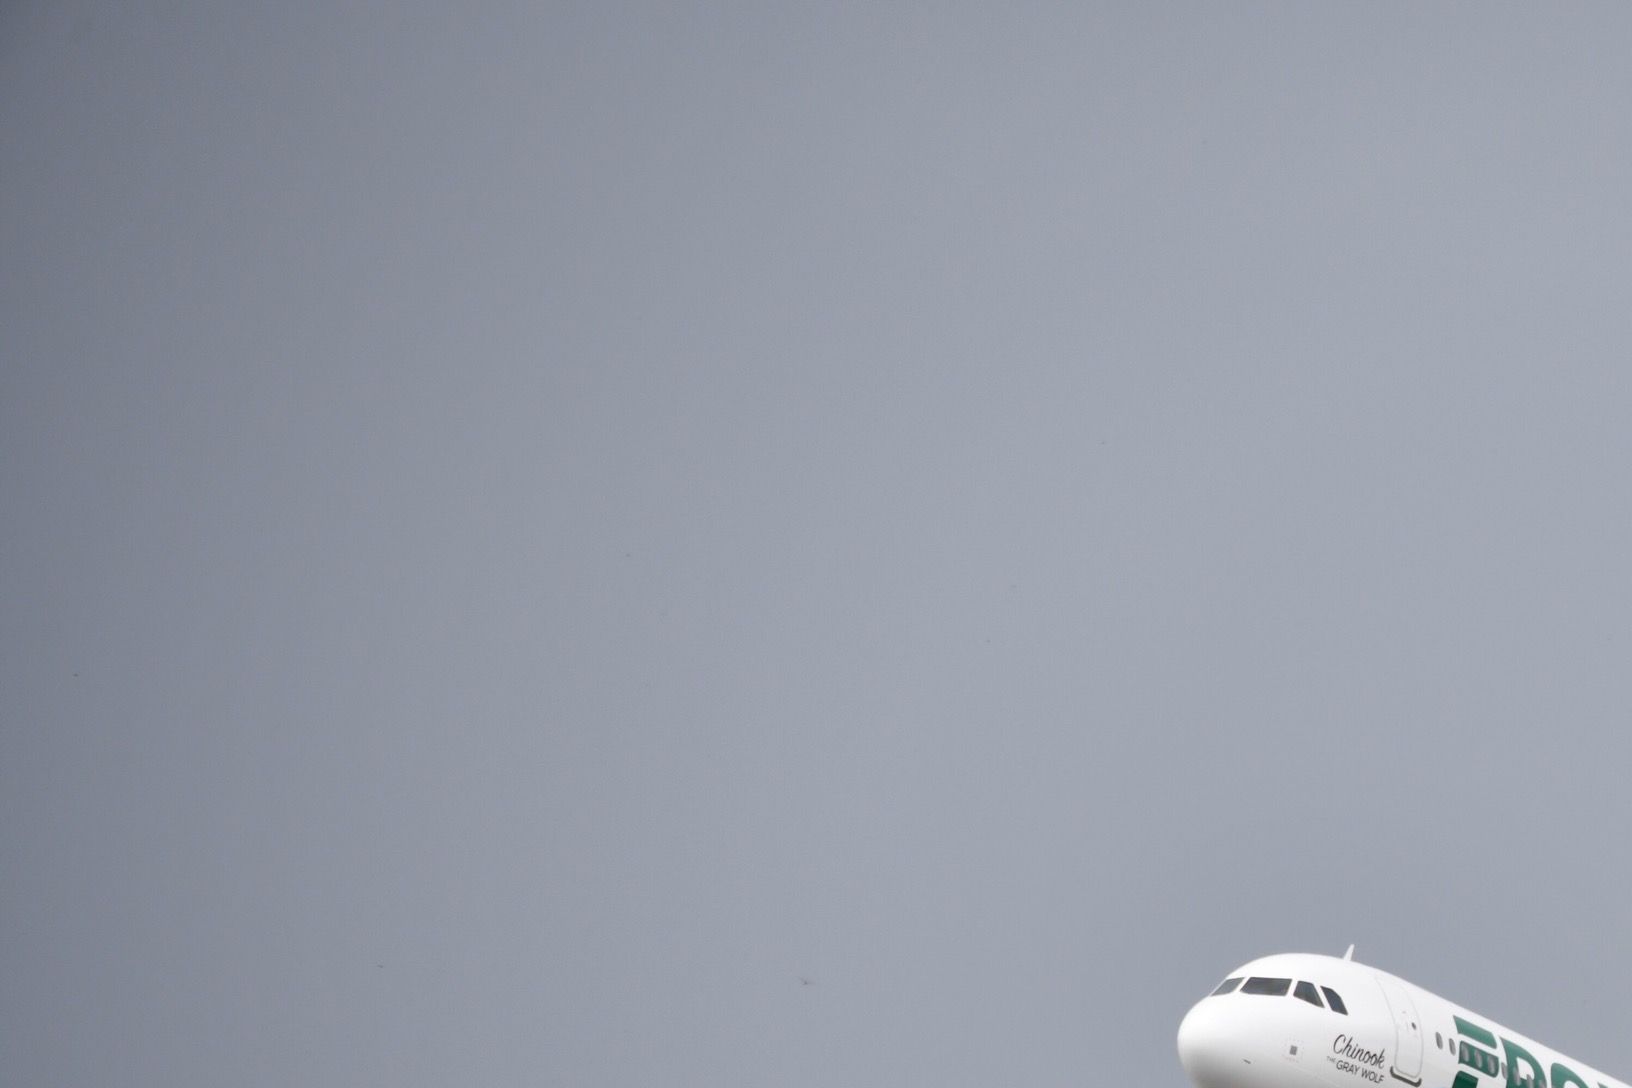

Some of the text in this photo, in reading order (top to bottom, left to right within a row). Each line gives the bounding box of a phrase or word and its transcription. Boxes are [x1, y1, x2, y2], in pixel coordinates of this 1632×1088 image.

[1333, 1033, 1385, 1069] Chinook
[1336, 1060, 1361, 1076] GRAY
[1361, 1067, 1385, 1084] WOLF
